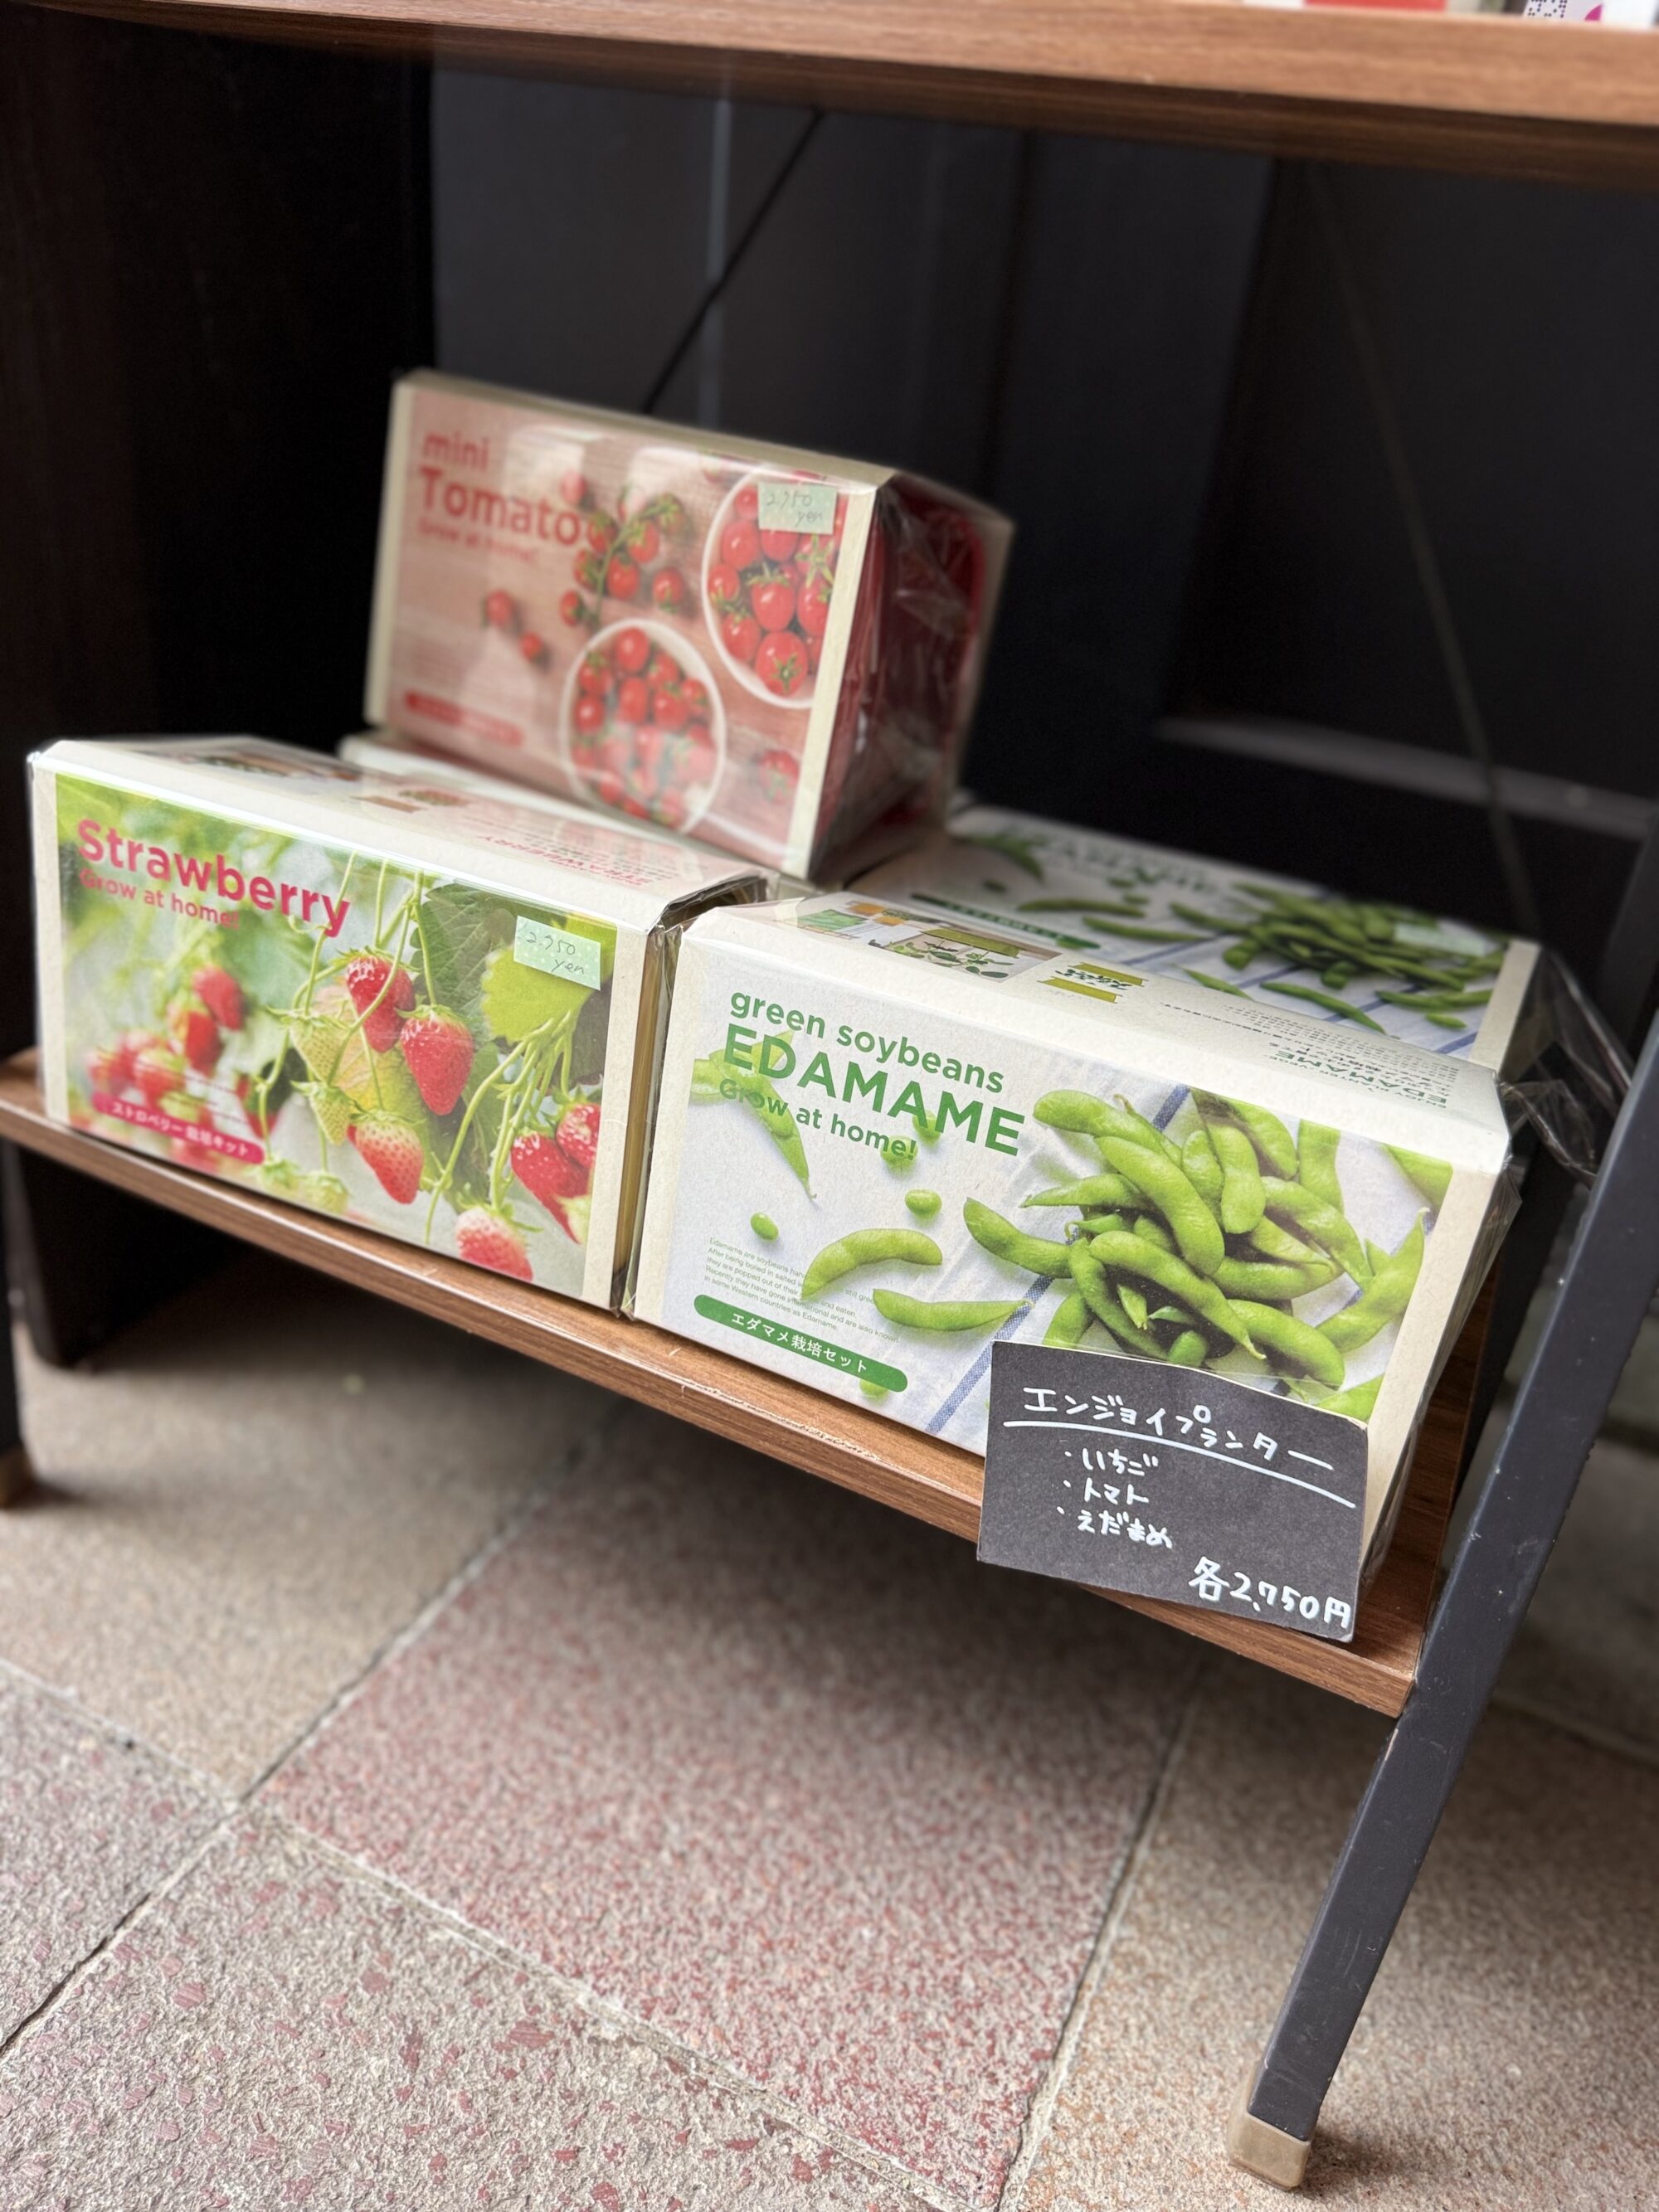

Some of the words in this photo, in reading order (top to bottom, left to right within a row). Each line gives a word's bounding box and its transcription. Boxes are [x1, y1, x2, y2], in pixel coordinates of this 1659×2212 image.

[423, 431, 489, 473] mini
[419, 465, 581, 546] Tomato
[77, 819, 351, 938] Strawberry
[79, 868, 137, 900] Grow
[144, 887, 165, 908] at
[171, 892, 240, 930] home!
[551, 959, 585, 975] yen
[730, 992, 825, 1039] green
[836, 1025, 1005, 1093] soybeans
[723, 1023, 1025, 1156] EDAMAME
[1274, 1049, 1447, 1104] EDAMAME
[719, 1077, 789, 1116] Grow
[795, 1107, 823, 1130] at
[830, 1113, 917, 1160] home!
[733, 1266, 761, 1281] popped
[761, 1277, 773, 1287] out
[751, 1283, 767, 1294] have
[768, 1290, 786, 1301] gone
[830, 1313, 844, 1323] and
[845, 1319, 857, 1328] are
[858, 1324, 873, 1334] also
[731, 1312, 867, 1373] エダマメ栽培セット
[1022, 1387, 1334, 1471] エンジョイプランター
